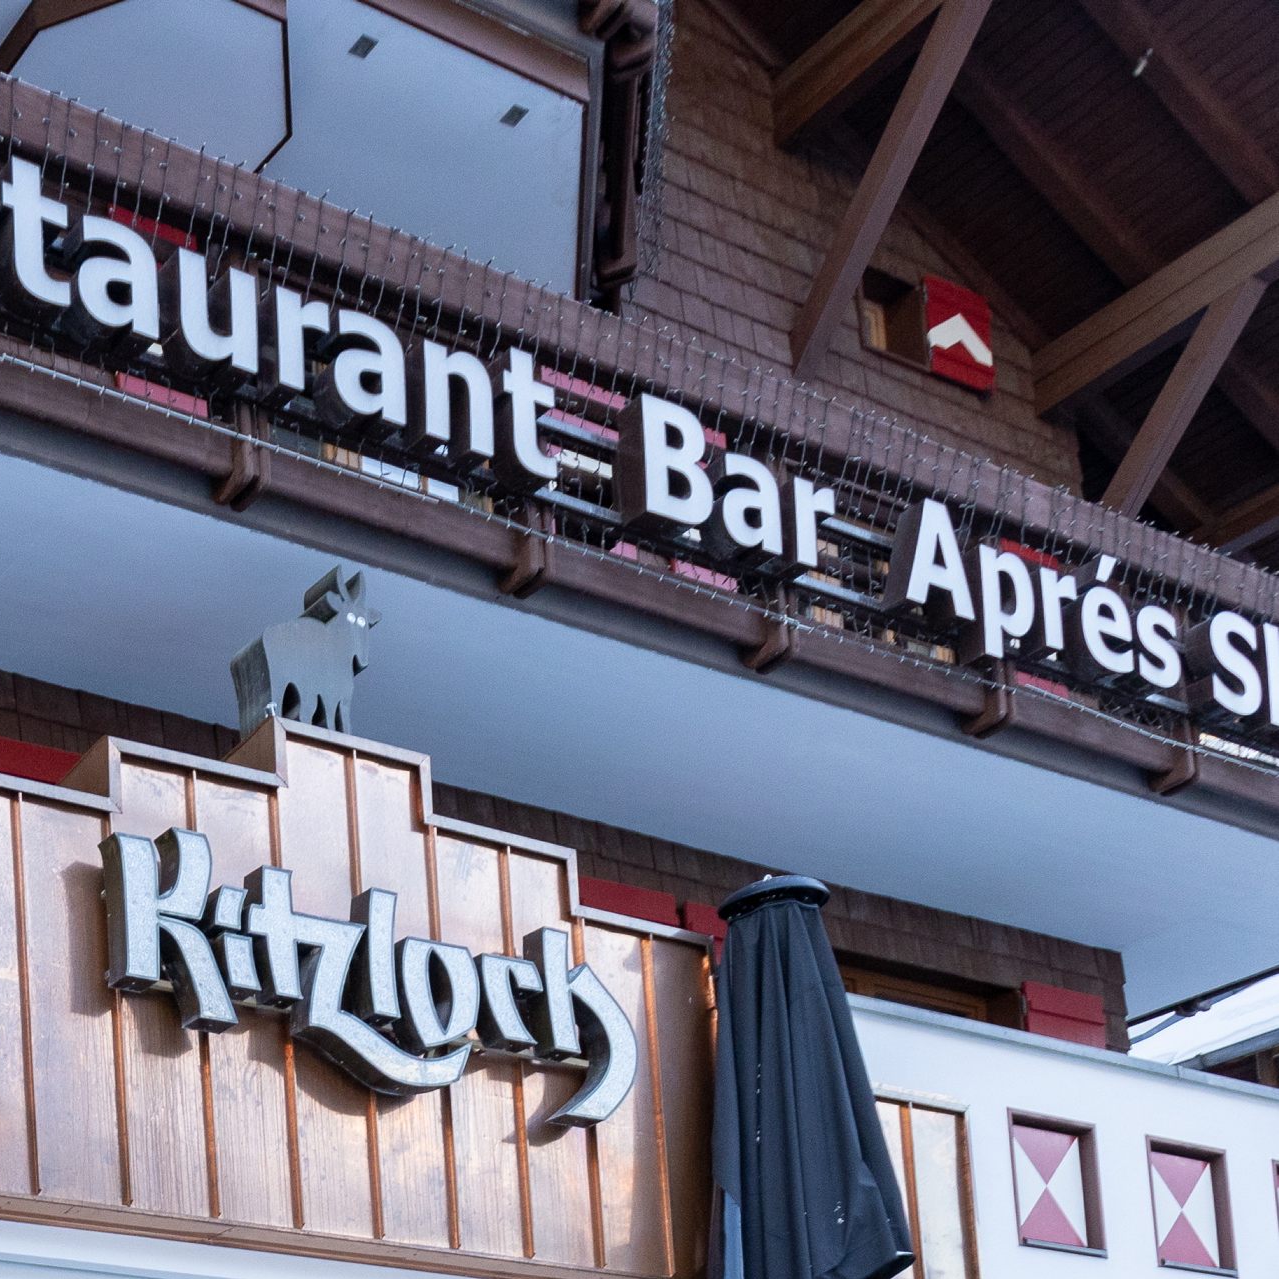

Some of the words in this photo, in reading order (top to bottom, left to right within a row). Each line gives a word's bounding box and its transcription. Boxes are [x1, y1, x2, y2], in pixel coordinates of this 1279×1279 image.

[640, 392, 837, 568] Bar
[905, 499, 1183, 689] Aprés
[1209, 610, 1279, 727] S
[101, 827, 638, 1128] Kitzloch
